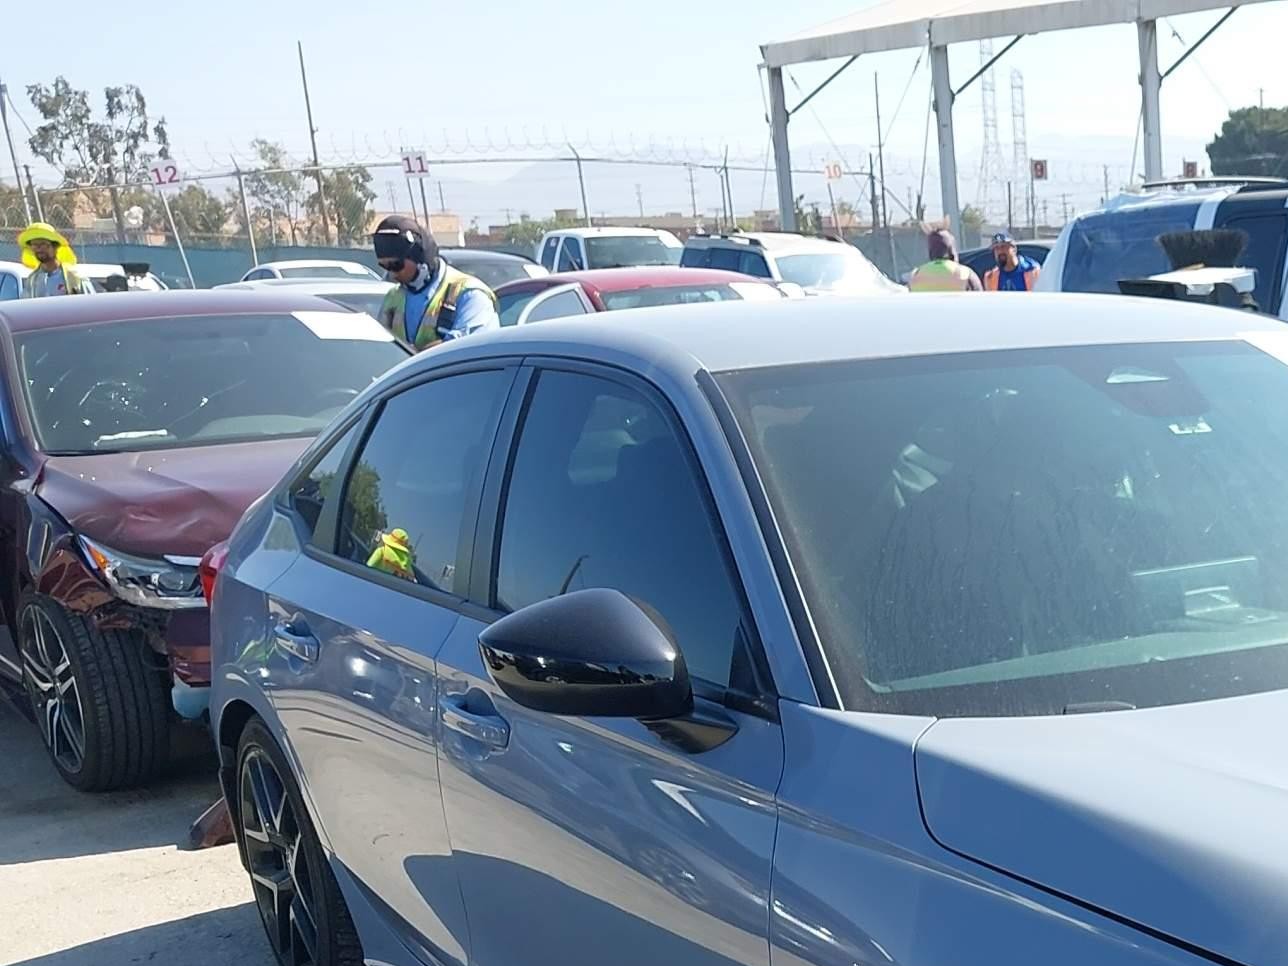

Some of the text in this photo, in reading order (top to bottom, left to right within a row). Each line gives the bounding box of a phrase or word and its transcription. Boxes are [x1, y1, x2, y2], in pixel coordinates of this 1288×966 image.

[402, 156, 429, 174] 11
[825, 164, 842, 179] 10
[150, 165, 180, 185] 12
